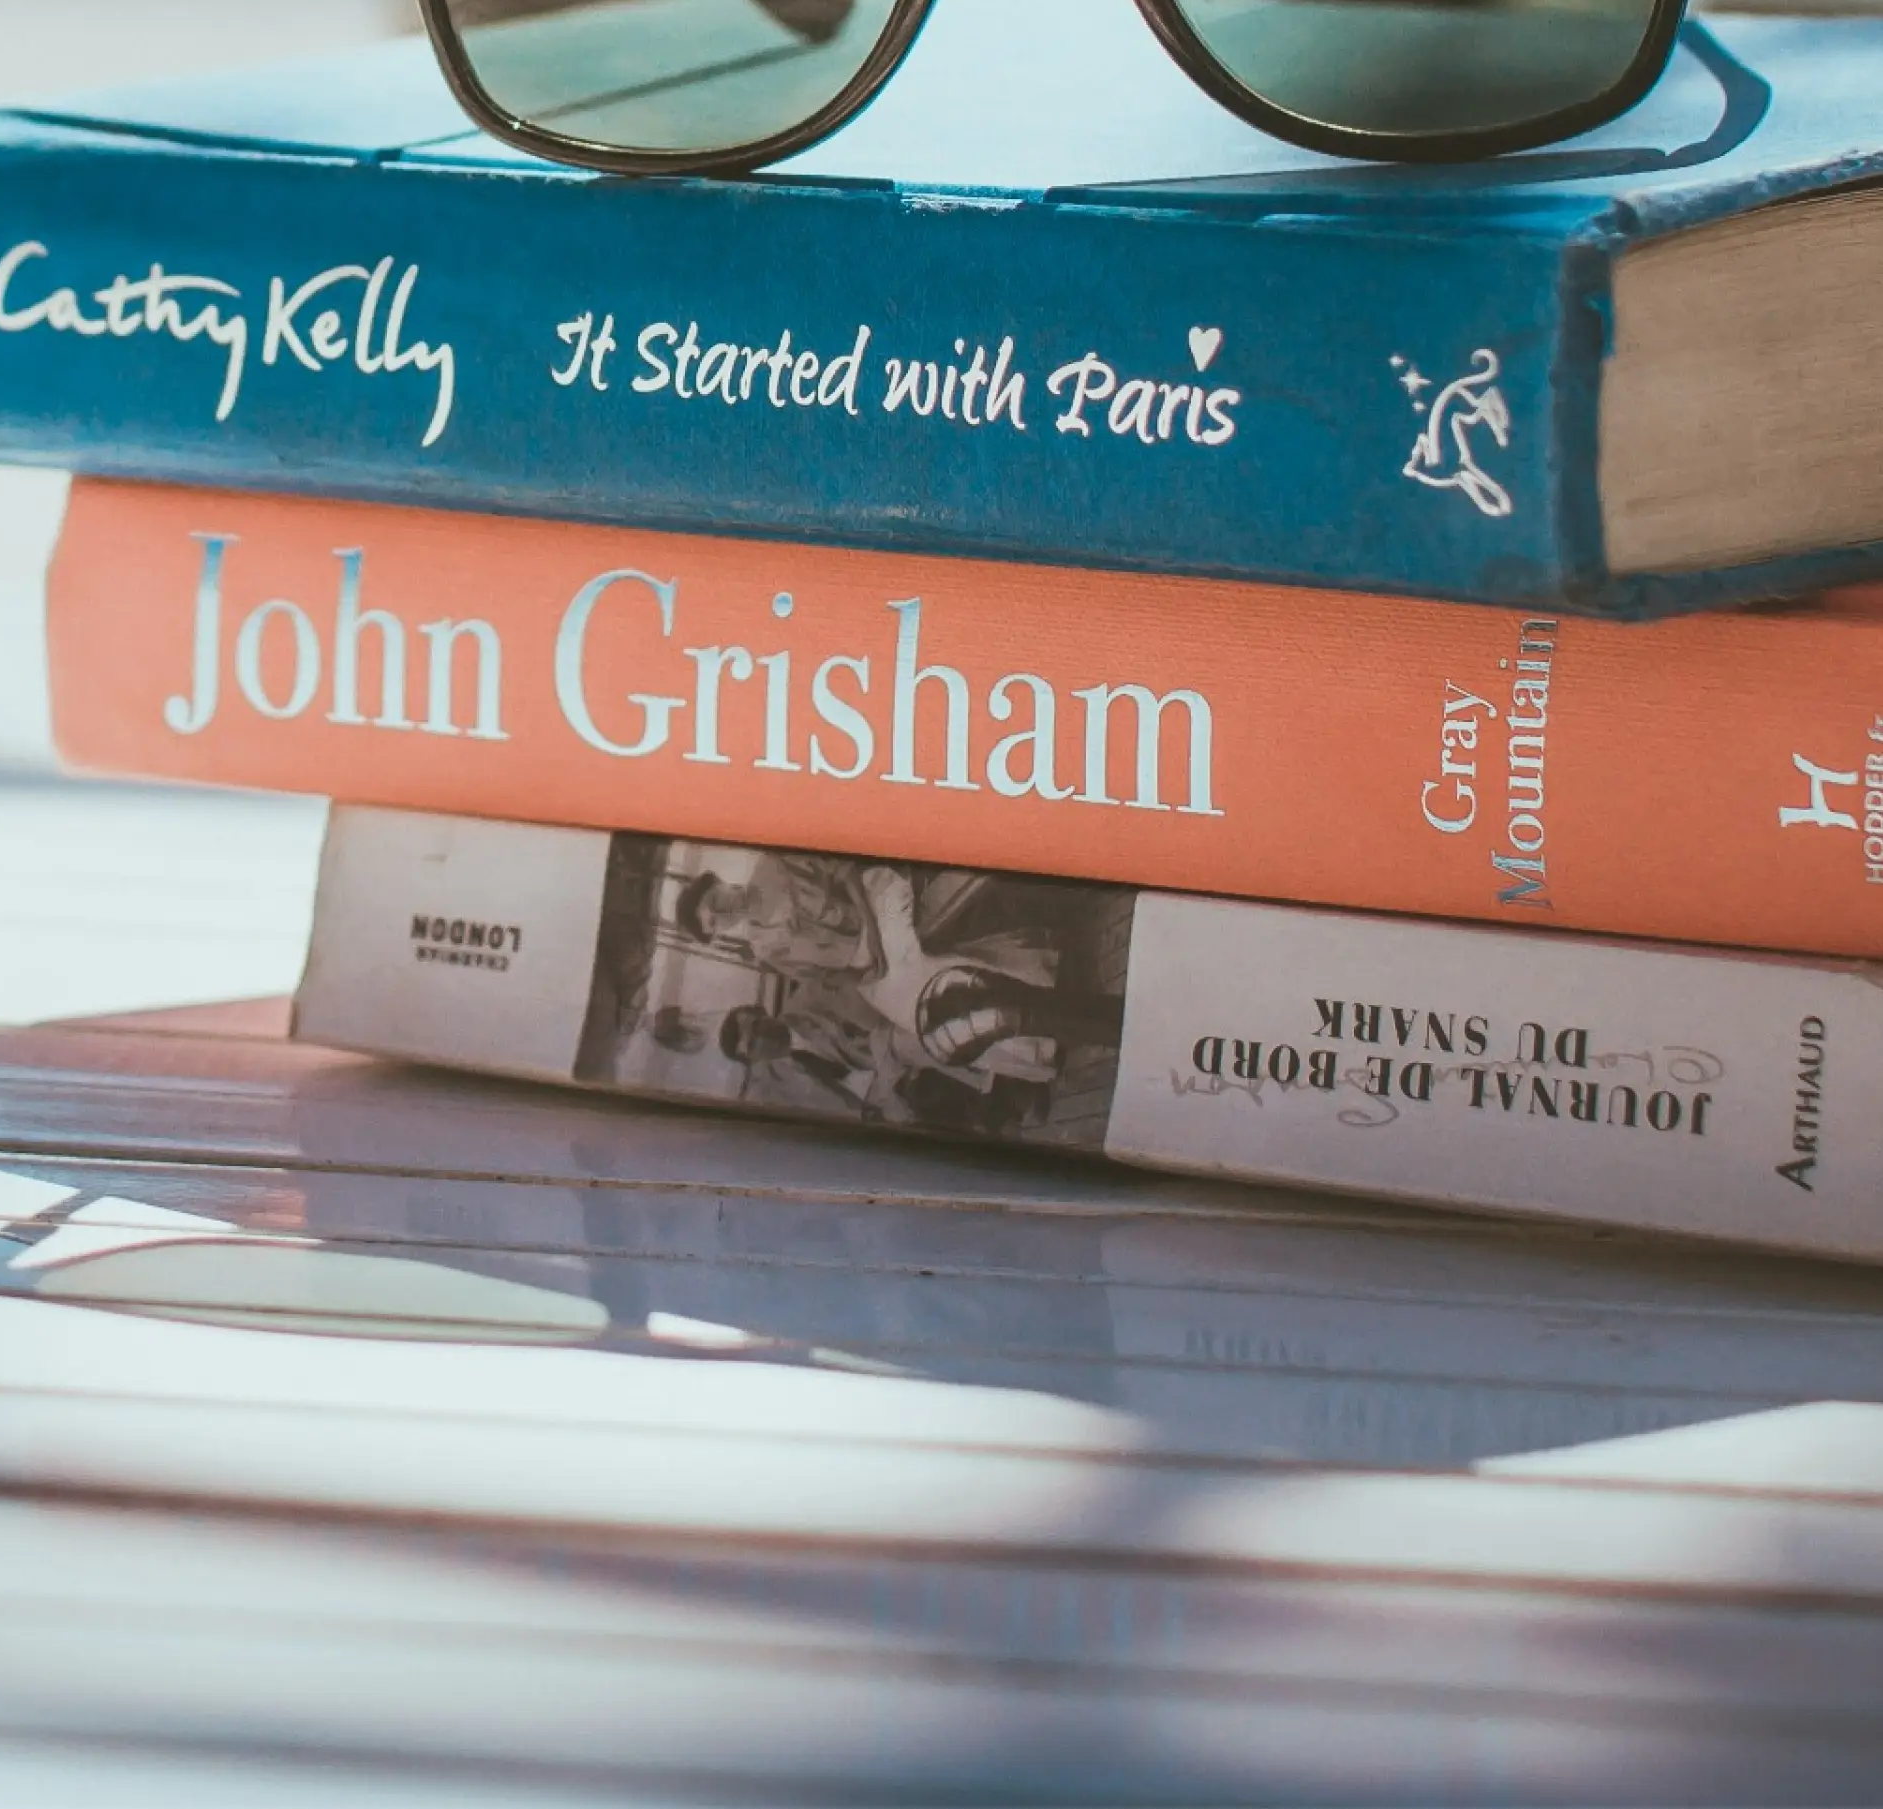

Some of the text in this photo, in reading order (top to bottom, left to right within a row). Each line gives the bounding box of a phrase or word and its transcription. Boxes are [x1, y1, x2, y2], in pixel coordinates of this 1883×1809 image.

[262, 256, 454, 447] Kelly
[551, 311, 1241, 445] It Started with Paris
[163, 531, 1225, 816] John Grisham
[1420, 678, 1498, 834] Gray
[1490, 619, 1559, 911] Mountain
[1863, 753, 1883, 884] HODDER
[410, 912, 521, 953] LONDON
[1192, 1036, 1713, 1135] JOURNAL DE BORD
[1311, 997, 1589, 1068] DU SNARK
